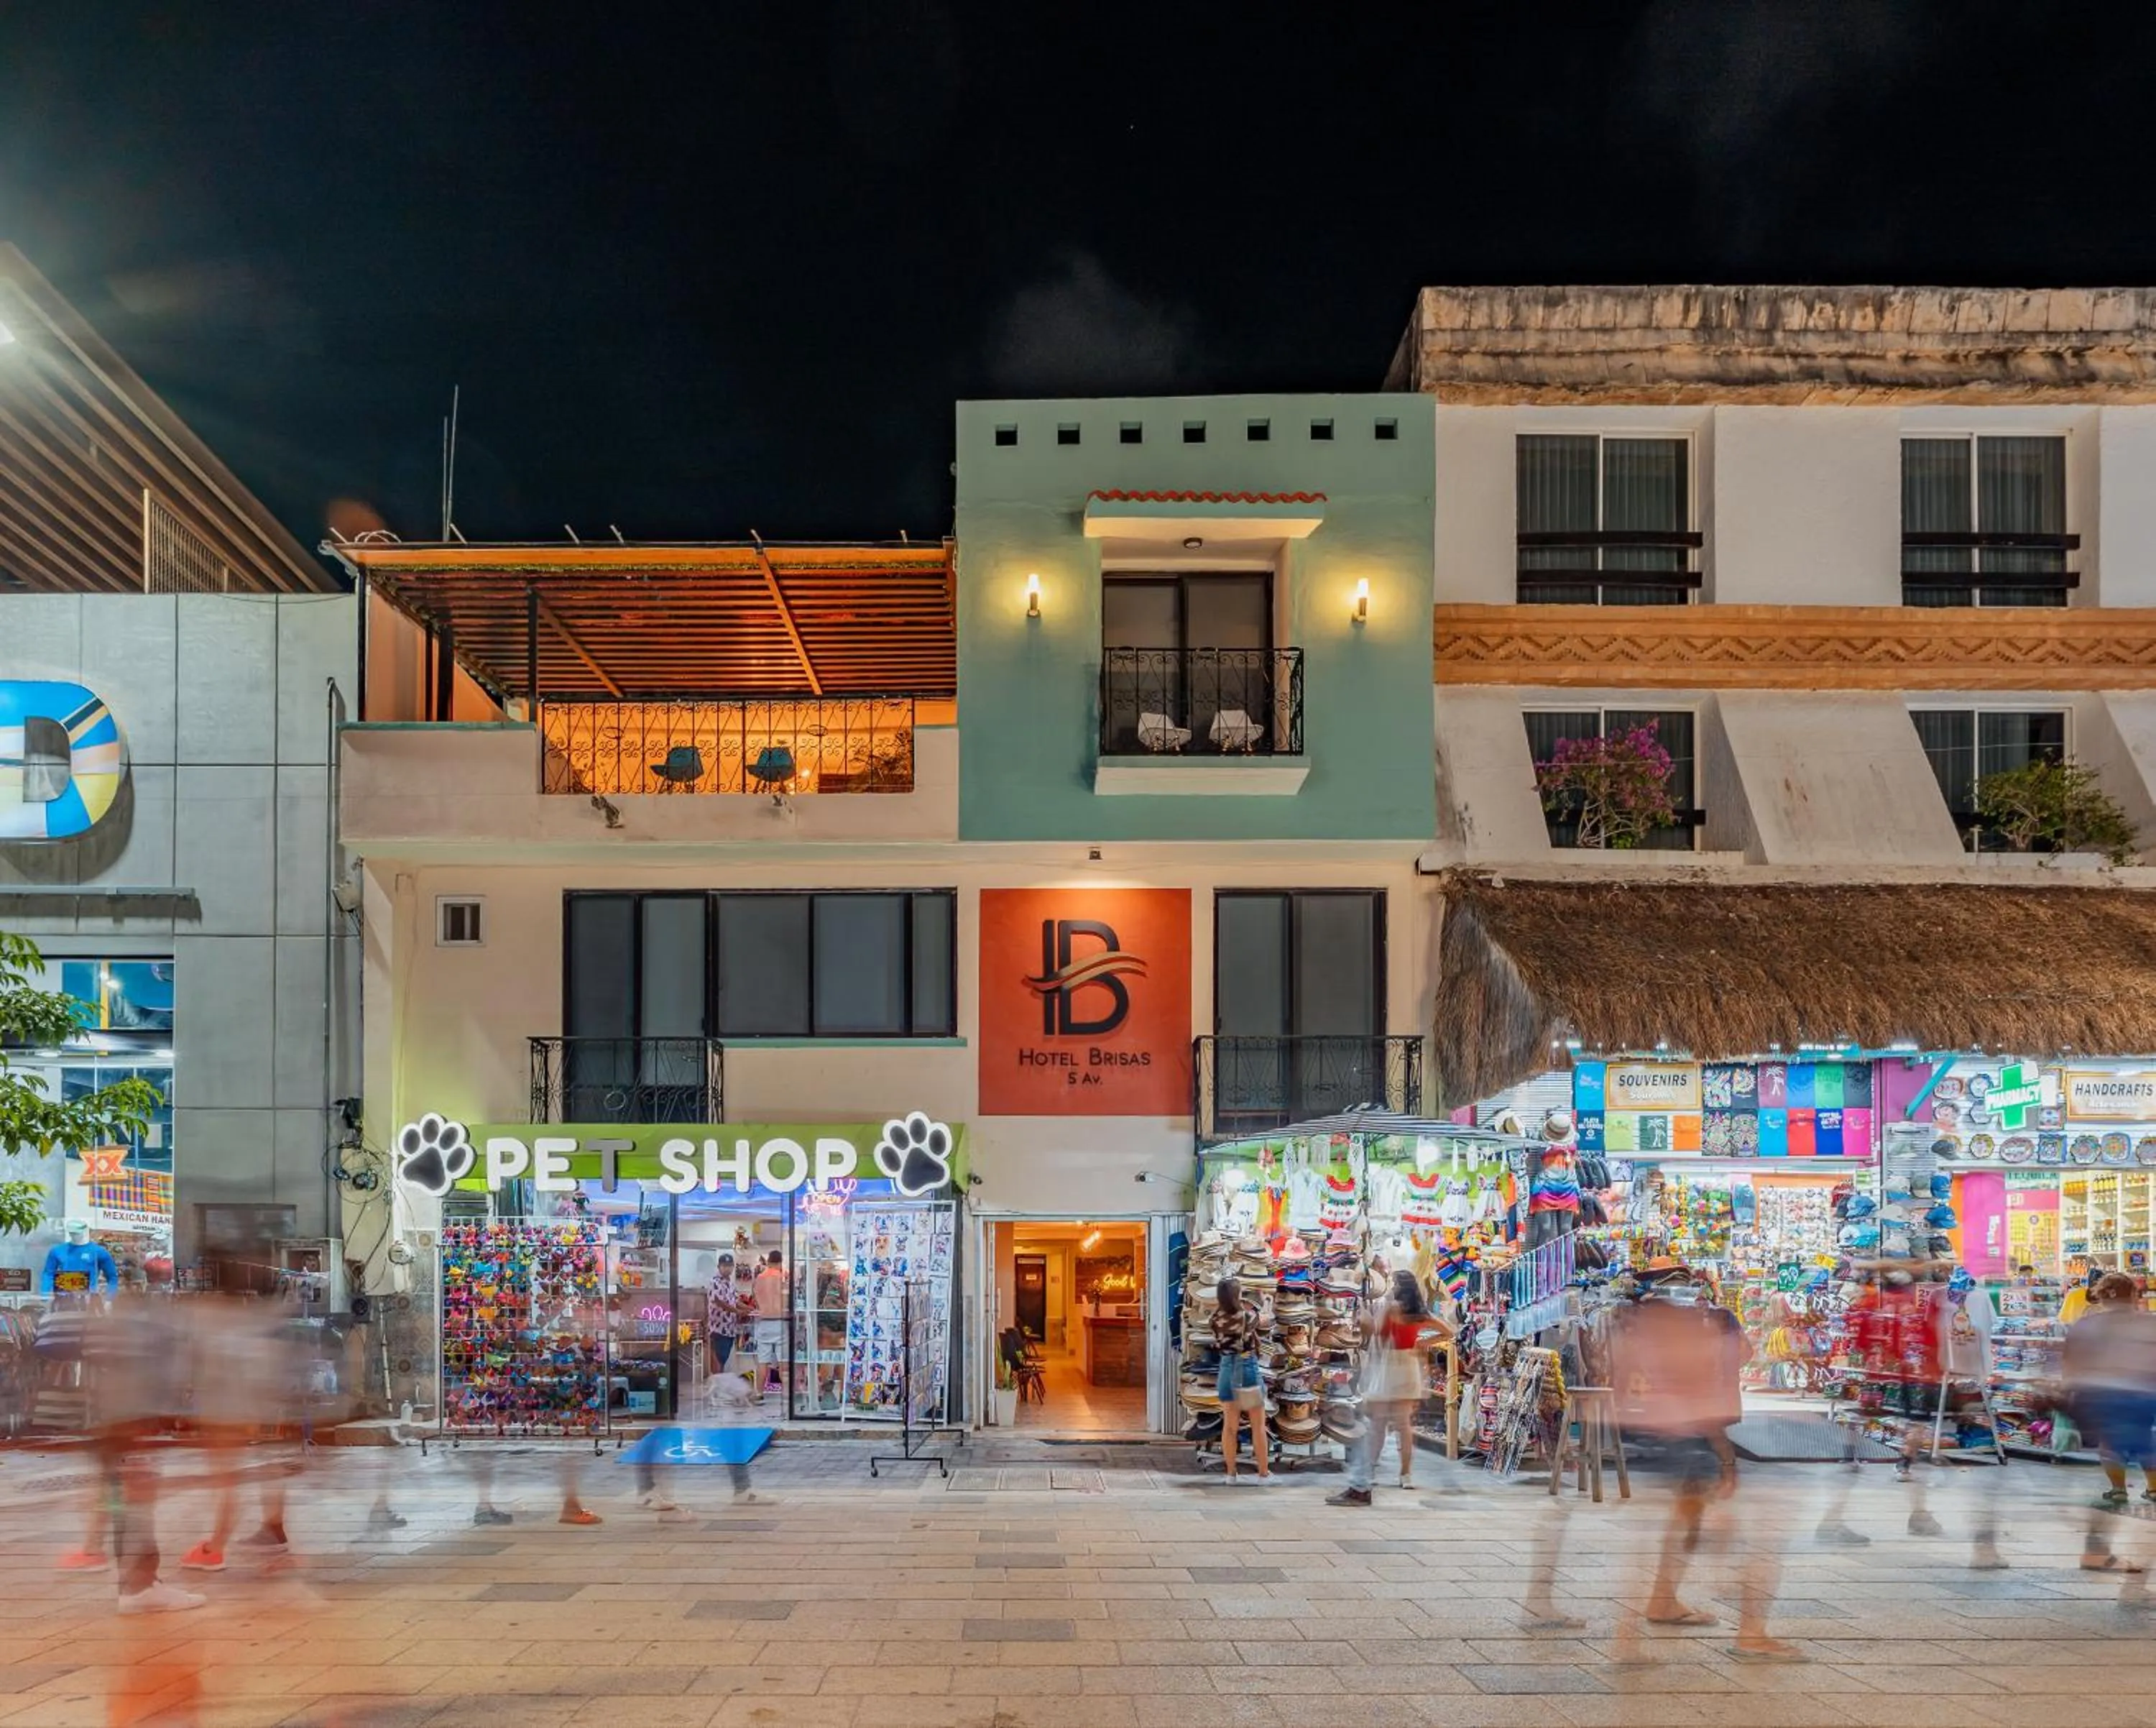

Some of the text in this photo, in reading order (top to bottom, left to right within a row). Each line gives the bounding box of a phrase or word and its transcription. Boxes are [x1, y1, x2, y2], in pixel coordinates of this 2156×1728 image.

[1019, 1047, 1151, 1066] HOTEL BRISAS
[1618, 1075, 1687, 1087] SOUVENIRS
[2075, 1083, 2153, 1096] HANDCRAFTS
[1986, 1085, 2040, 1111] PHARMACY
[486, 1137, 857, 1193] PET SHOP
[103, 1210, 149, 1223] MEXICAN
[1102, 1273, 1128, 1291] Good
